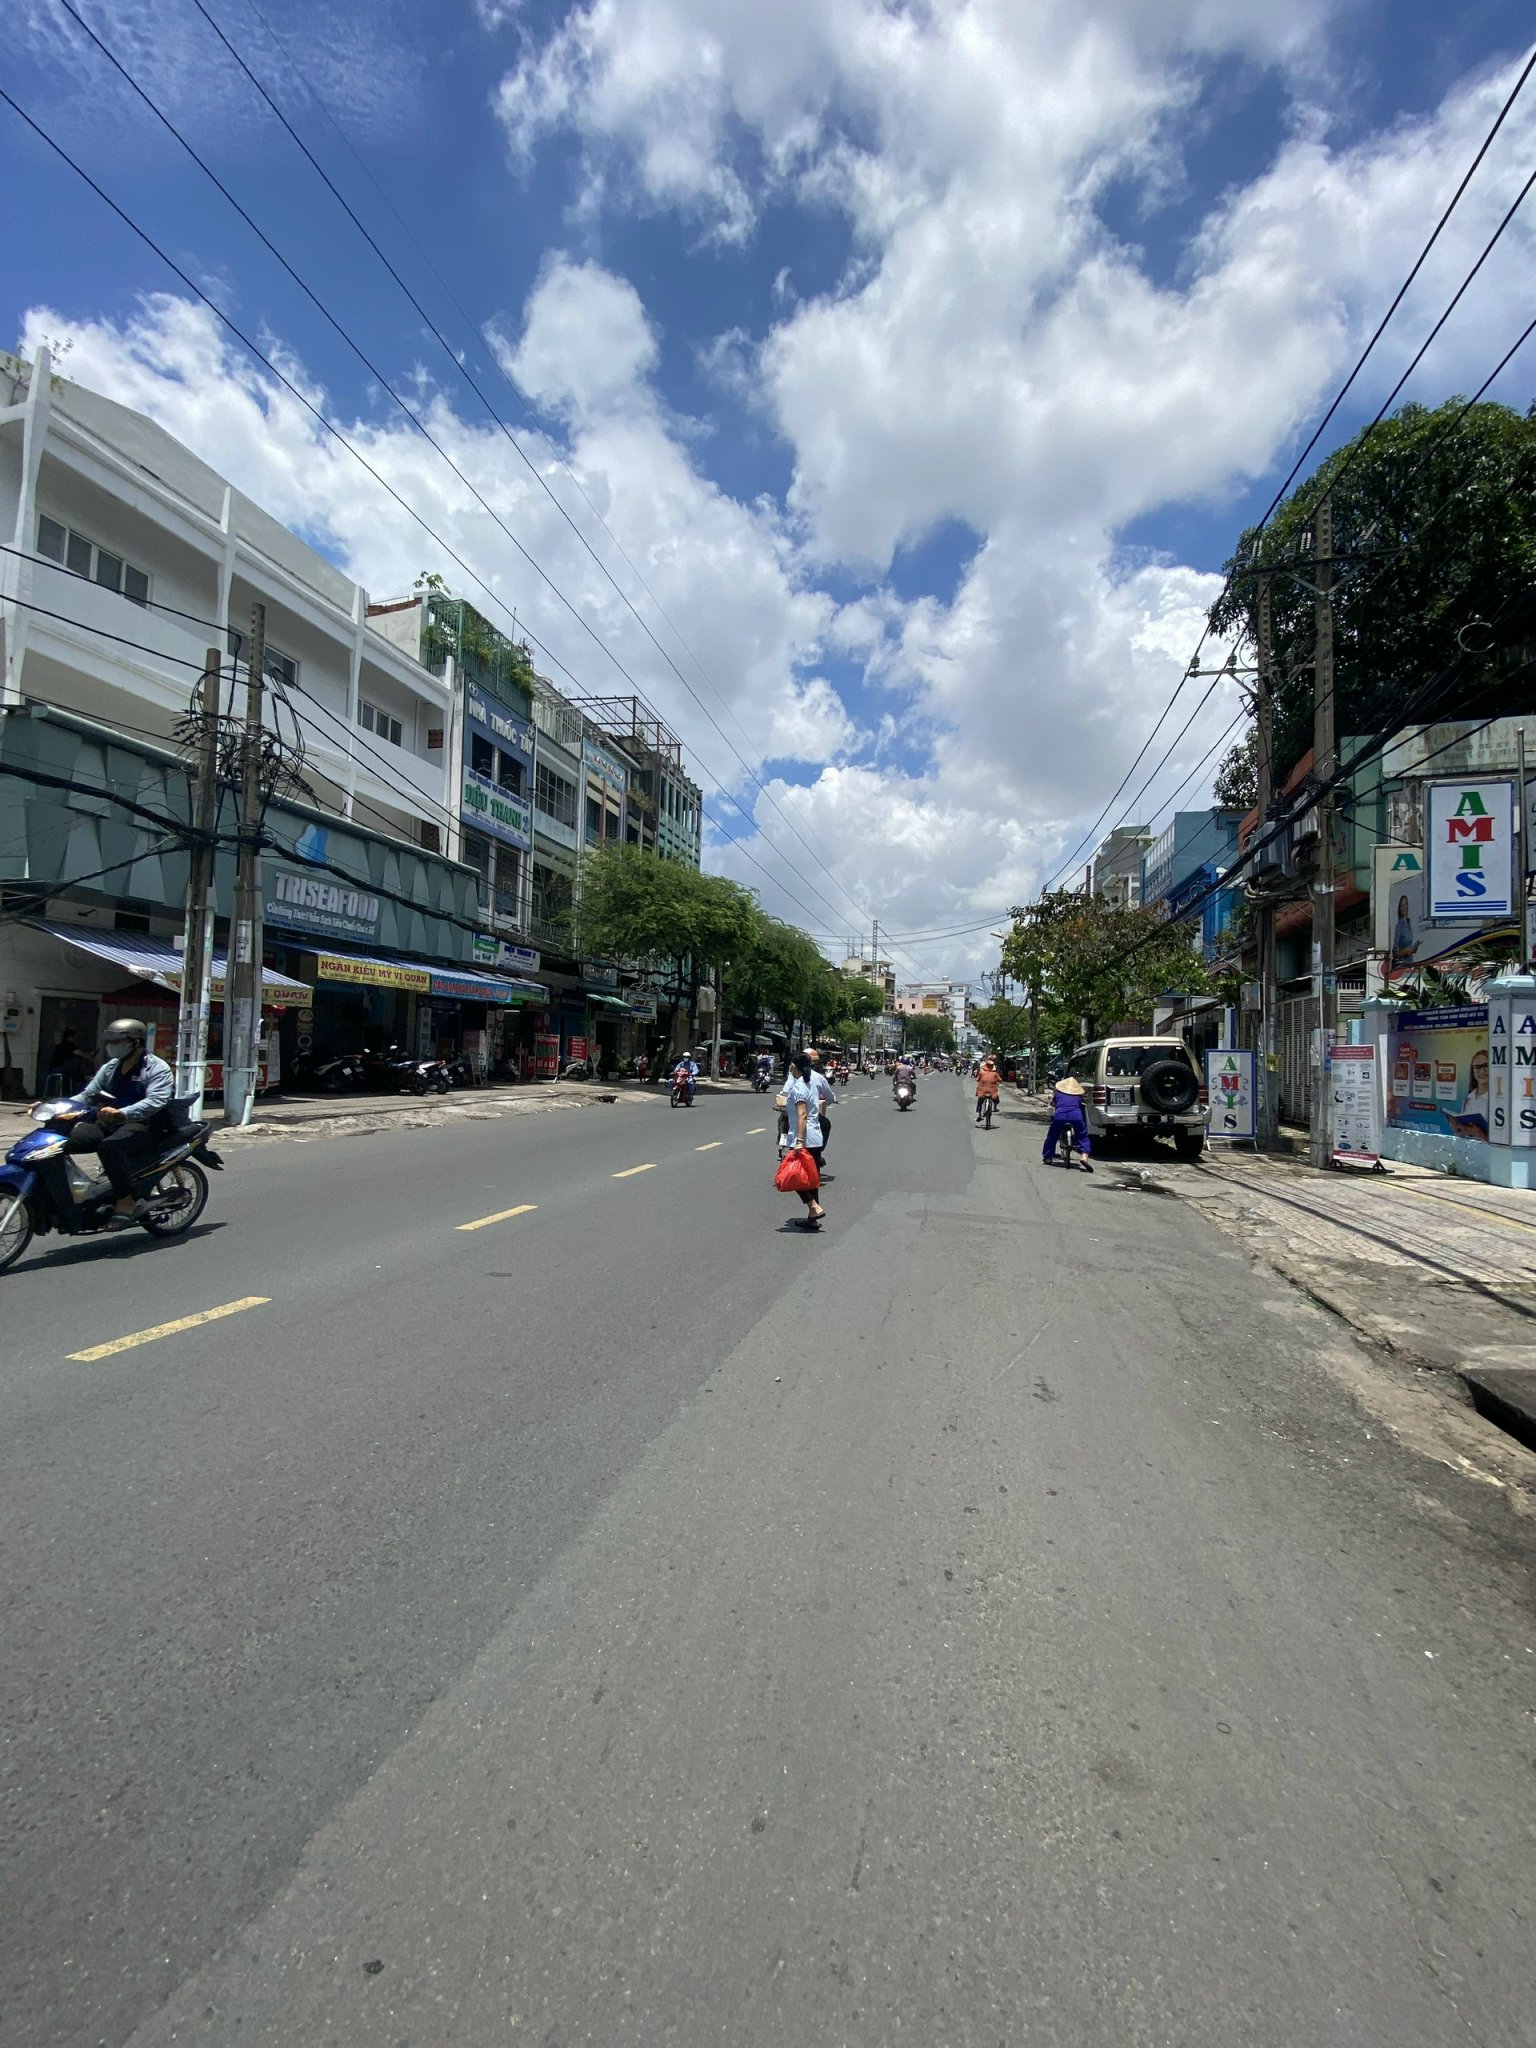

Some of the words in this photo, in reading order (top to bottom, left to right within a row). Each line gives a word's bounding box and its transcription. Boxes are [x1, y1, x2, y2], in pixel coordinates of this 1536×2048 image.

[468, 697, 487, 726] NHÀ
[490, 712, 517, 745] THUỐC
[491, 798, 522, 831] THANH
[522, 815, 529, 834] 2
[1446, 791, 1496, 898] AMIS
[275, 871, 379, 923] TRISEAFOOD
[1219, 1055, 1241, 1129] AMIS
[1490, 1015, 1508, 1127] AMIS
